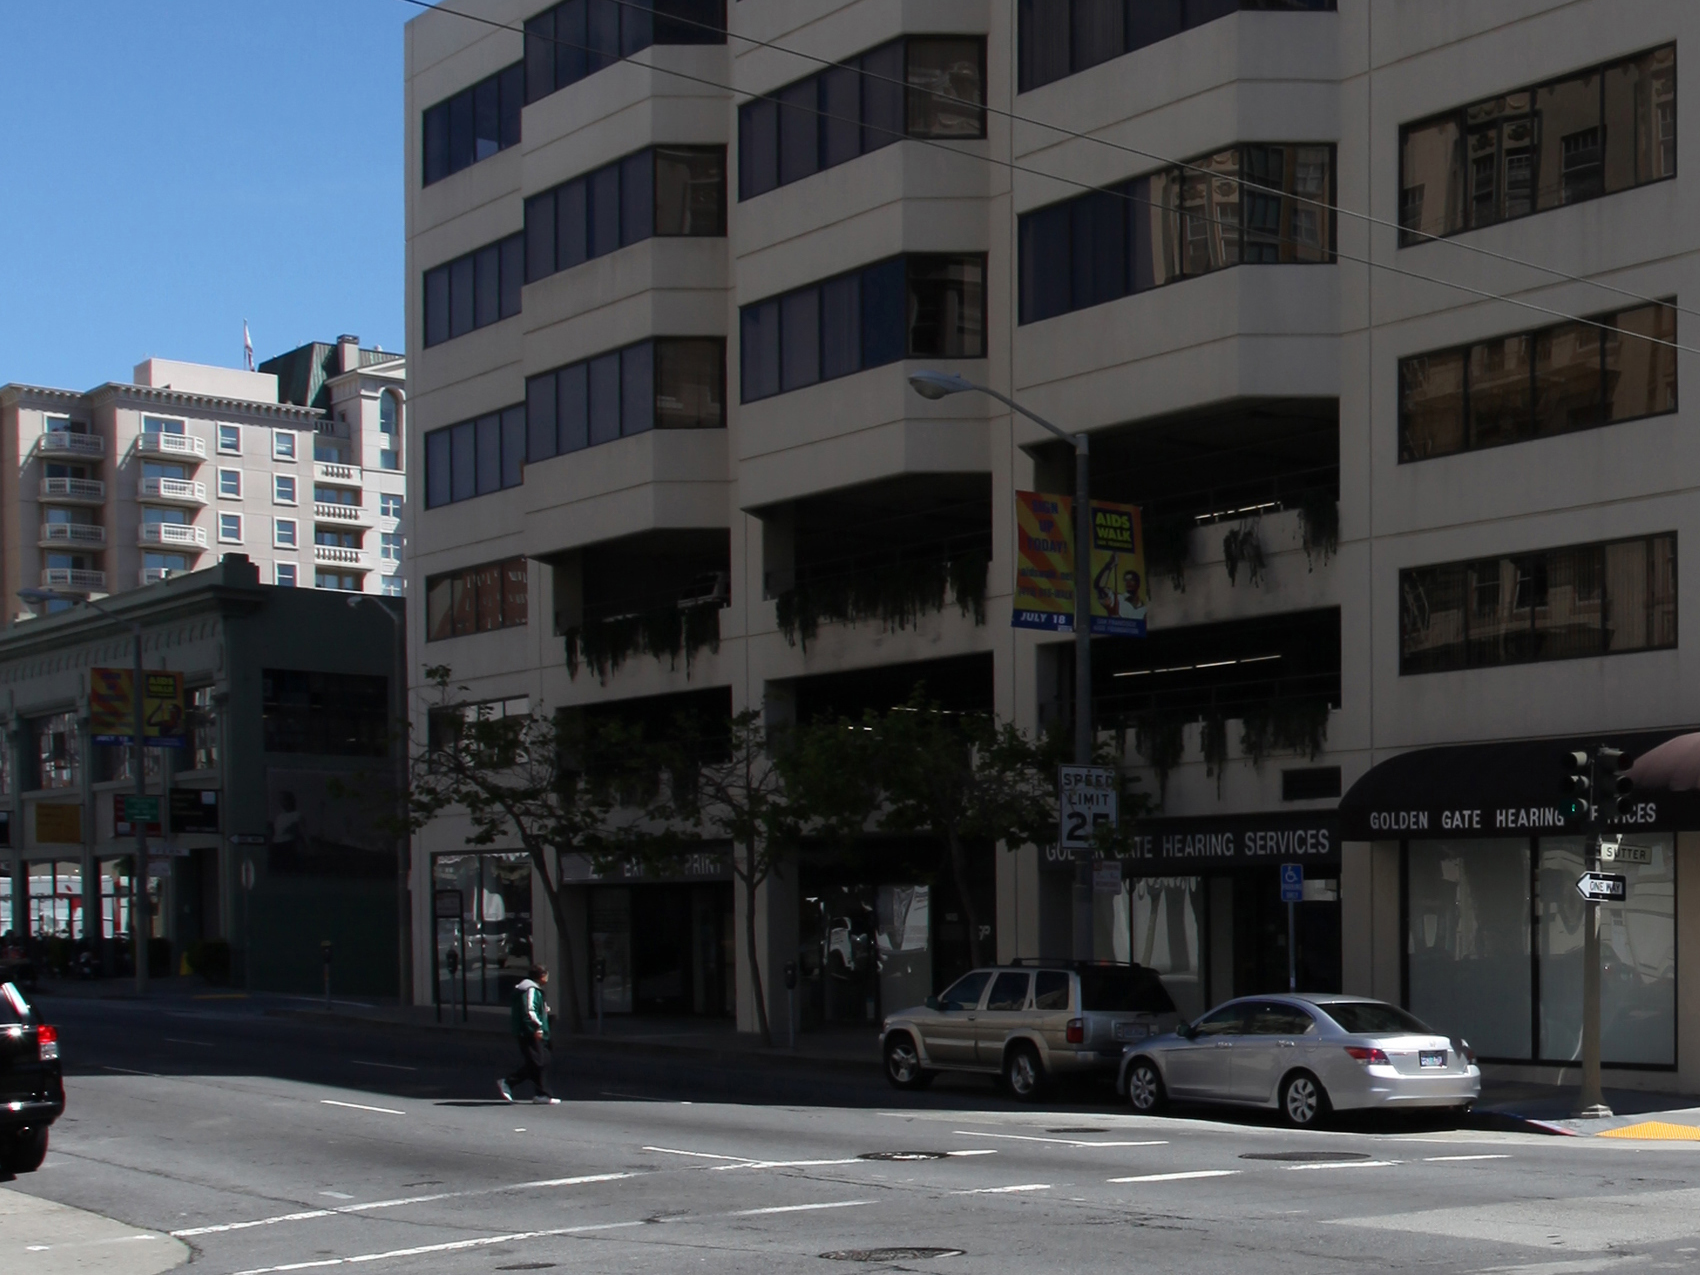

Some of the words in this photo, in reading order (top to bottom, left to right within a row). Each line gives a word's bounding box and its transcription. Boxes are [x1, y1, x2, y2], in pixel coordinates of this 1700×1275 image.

[1039, 519, 1054, 533] UP
[1095, 511, 1130, 528] AIDS
[1096, 526, 1131, 541] WALK
[1027, 536, 1067, 554] TODAY!
[1020, 613, 1048, 622] JULY
[1052, 614, 1066, 624] 18
[1063, 773, 1114, 788] SPEED
[1068, 793, 1109, 806] LIMIT
[1370, 811, 1429, 830] GOLDEN
[1441, 809, 1482, 829] GATE
[1496, 807, 1565, 828] HEARING
[1115, 835, 1153, 859] ATE
[1163, 832, 1235, 858] HEARING
[1244, 829, 1330, 857] SERVICES
[1606, 846, 1646, 860] SUTTER
[1590, 881, 1603, 893] ONE
[1606, 882, 1621, 894] WAY
